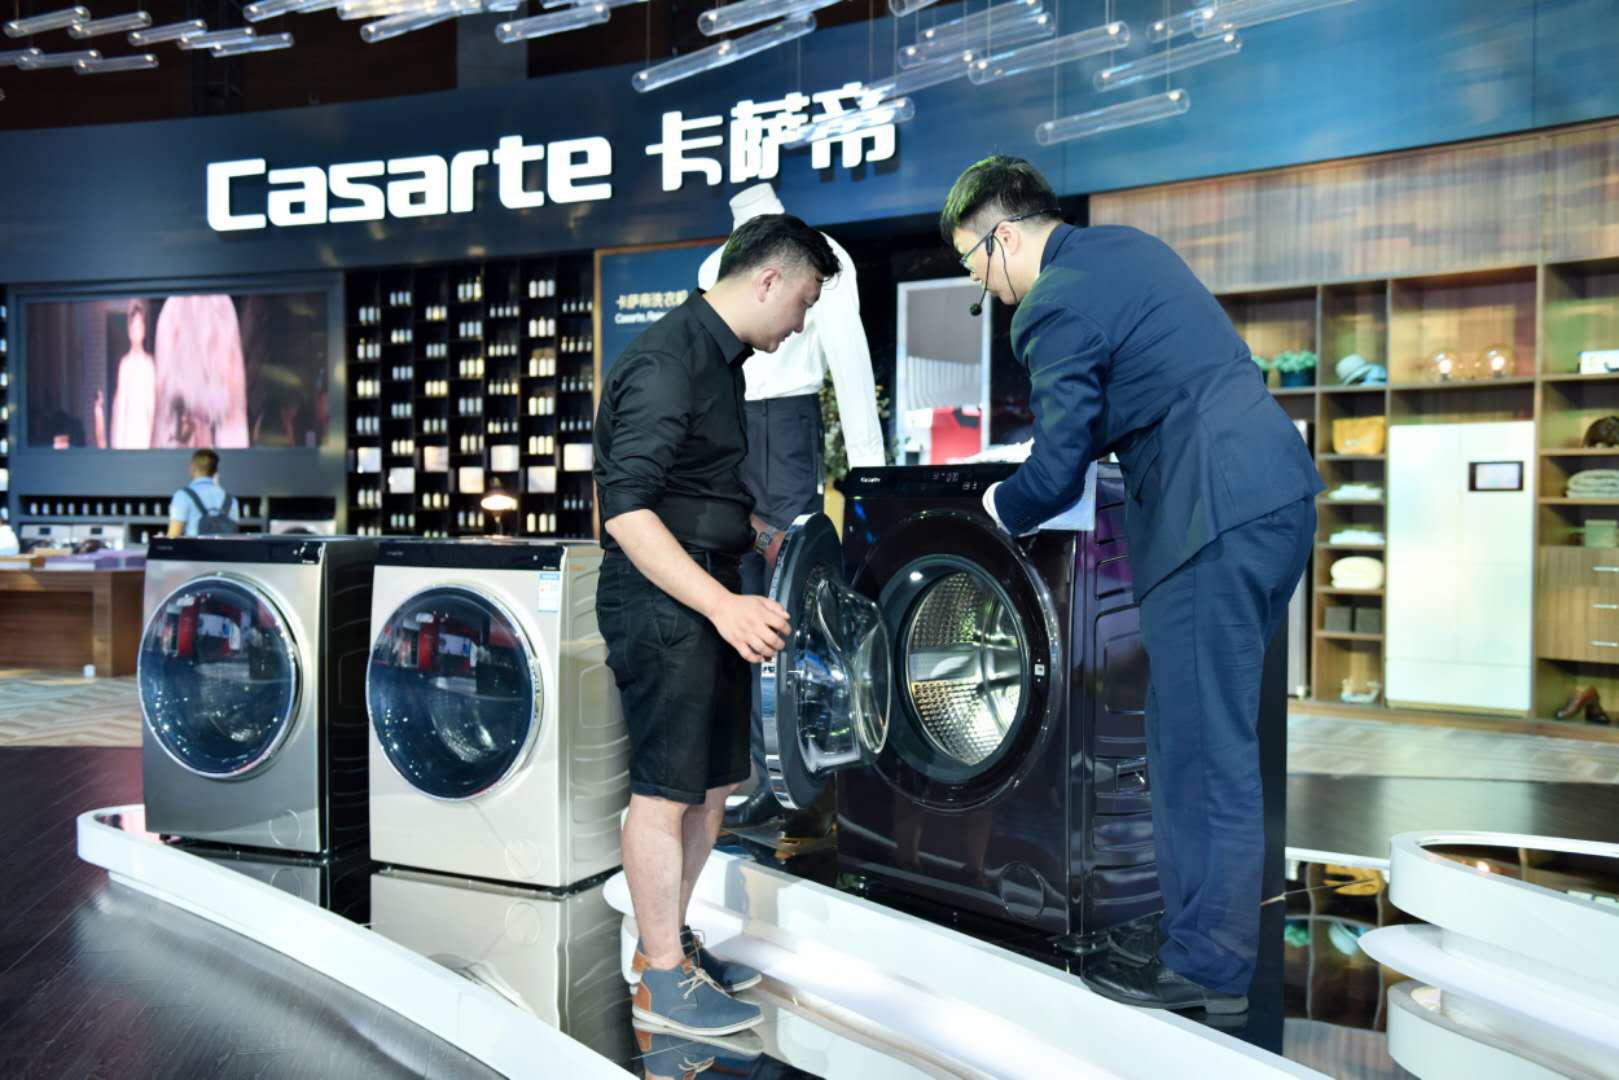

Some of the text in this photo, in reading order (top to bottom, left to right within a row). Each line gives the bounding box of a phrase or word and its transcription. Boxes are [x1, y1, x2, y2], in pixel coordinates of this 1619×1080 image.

[207, 135, 612, 231] Casarte
[646, 81, 897, 192] 卡萨帝
